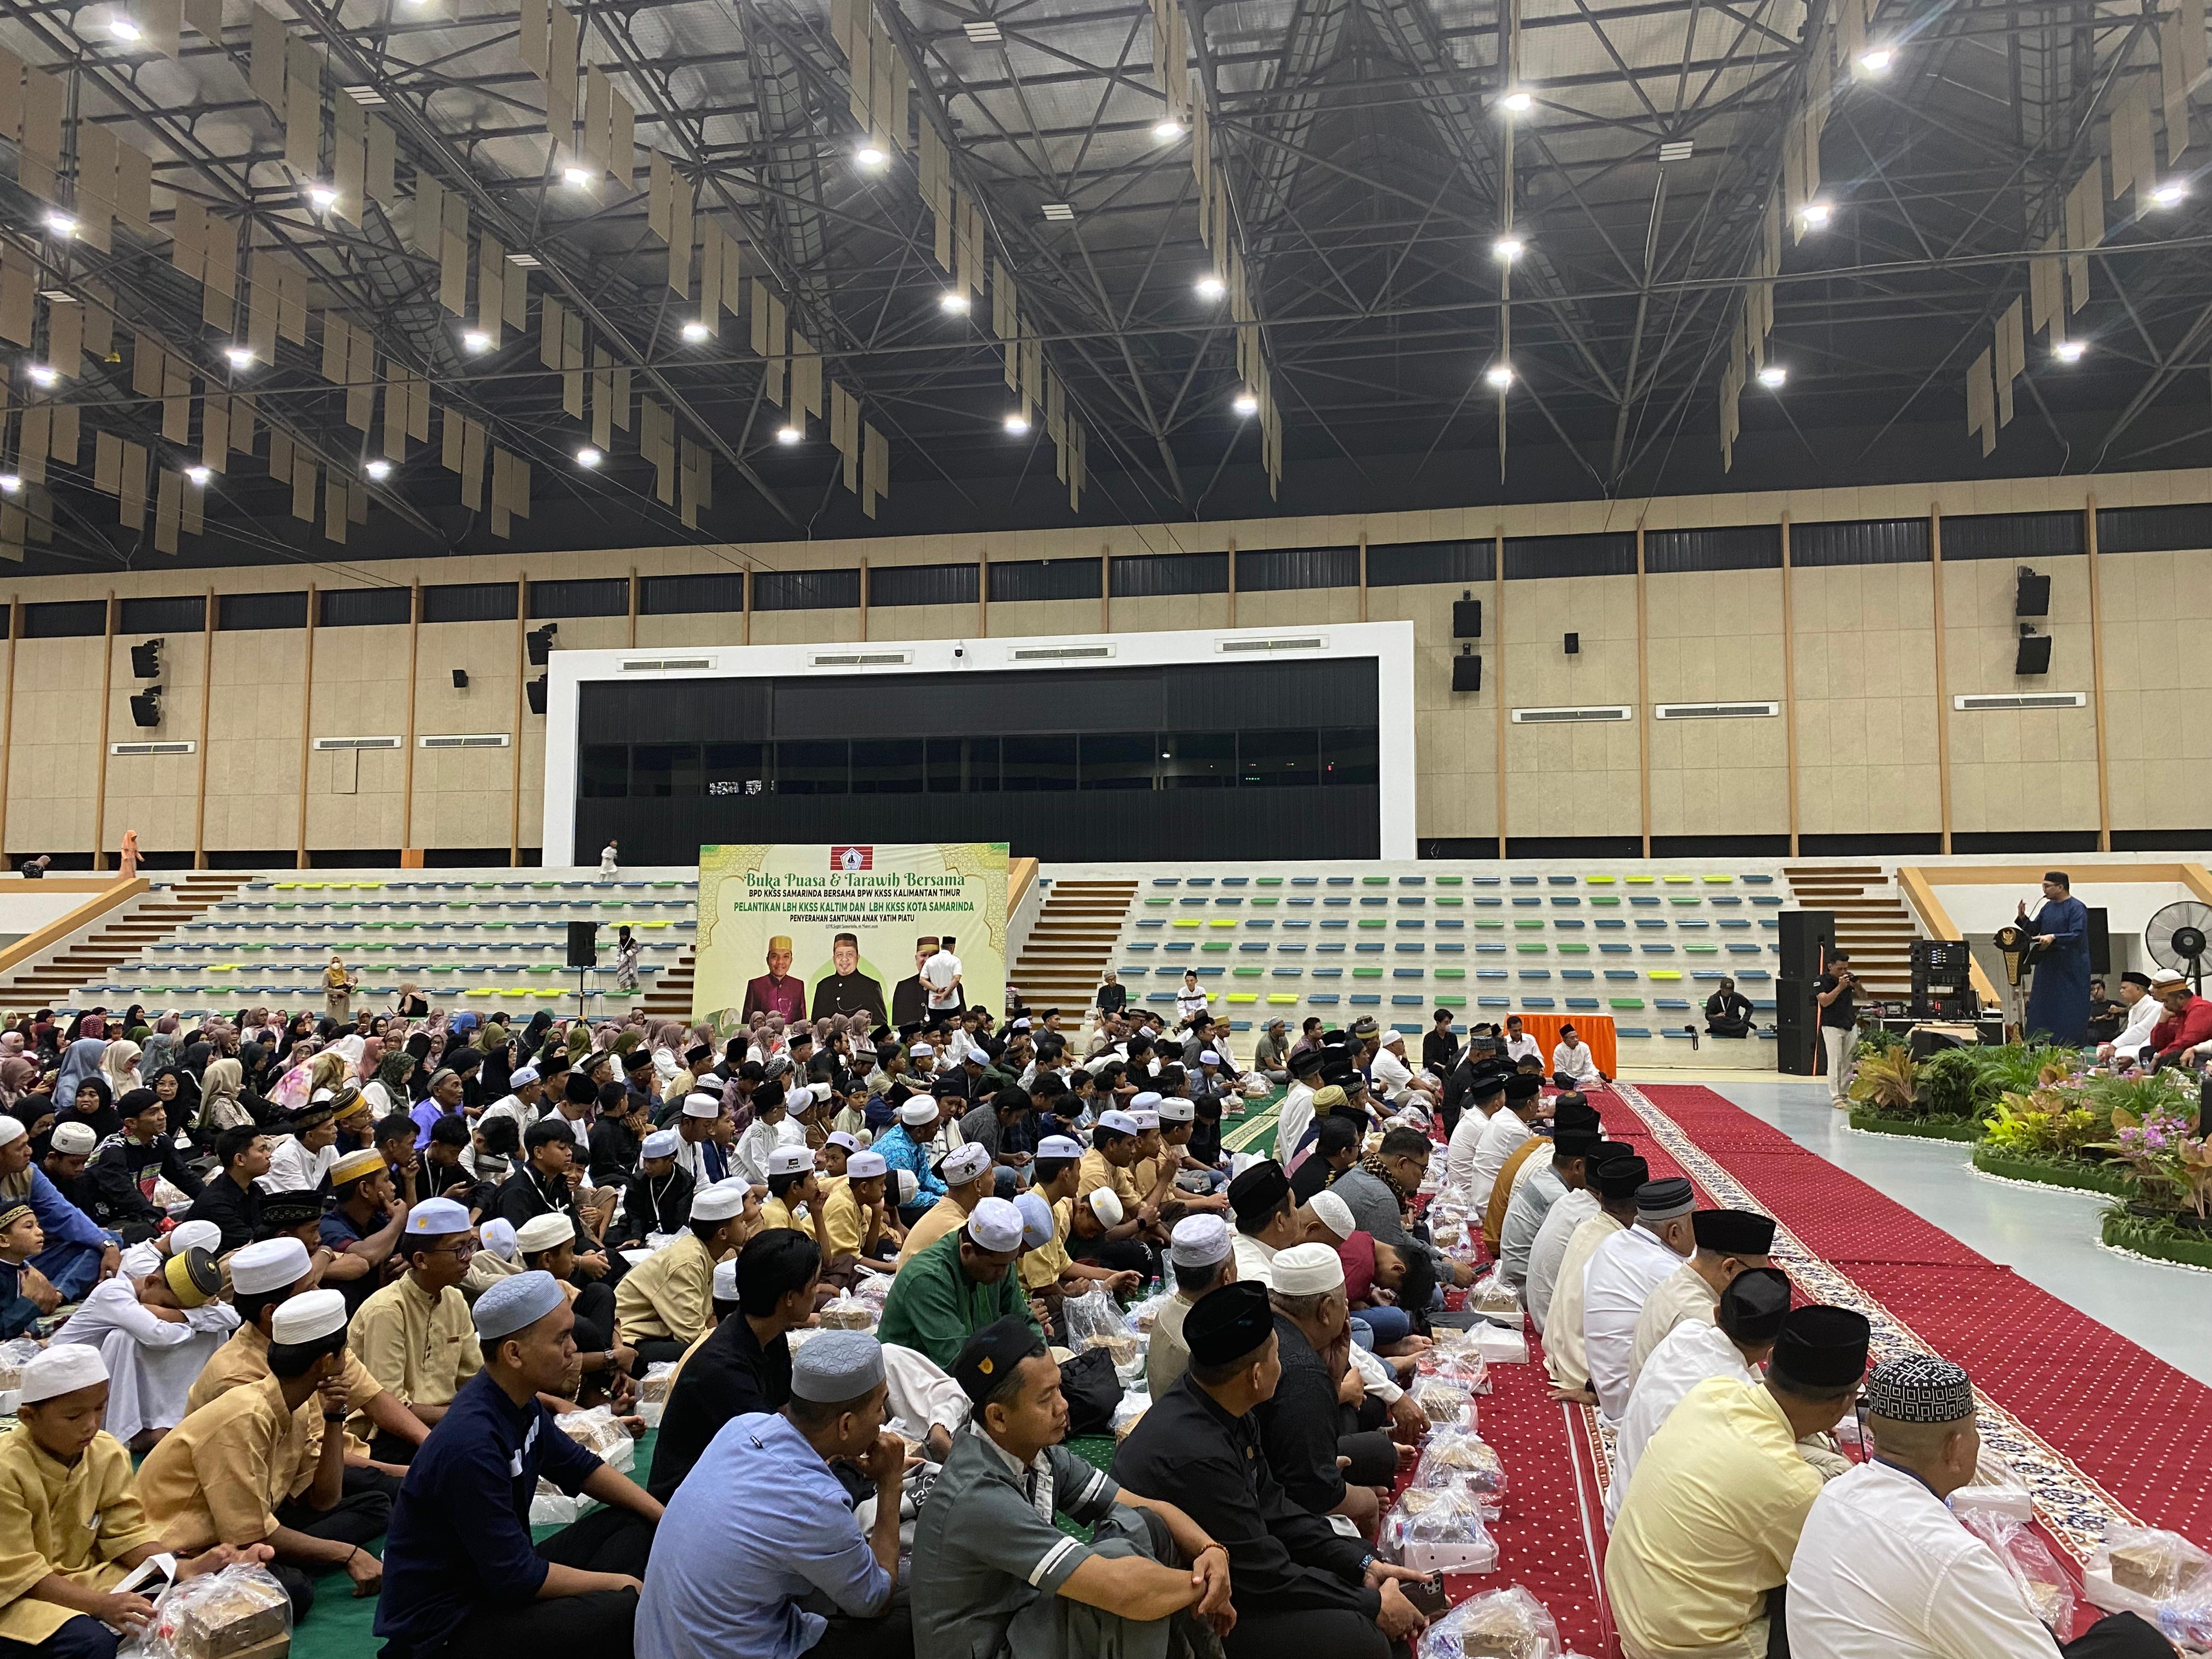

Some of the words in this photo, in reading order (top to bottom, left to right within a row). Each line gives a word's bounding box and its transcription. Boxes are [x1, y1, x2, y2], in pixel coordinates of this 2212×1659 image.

[743, 873, 781, 889] Buka
[785, 873, 826, 887] Puasa
[830, 873, 841, 887] &
[844, 872, 900, 887] Tarawih
[904, 873, 965, 886] Bersama
[734, 902, 780, 912] PELANTIKAN
[782, 902, 797, 912] LBH
[799, 902, 818, 912] KKSS
[820, 902, 848, 912] KALTIM
[850, 902, 865, 912] DAN
[869, 902, 884, 912] LBH
[885, 902, 905, 912] KKSS
[907, 902, 927, 912] KOTA
[929, 902, 974, 912] SAMARINDA
